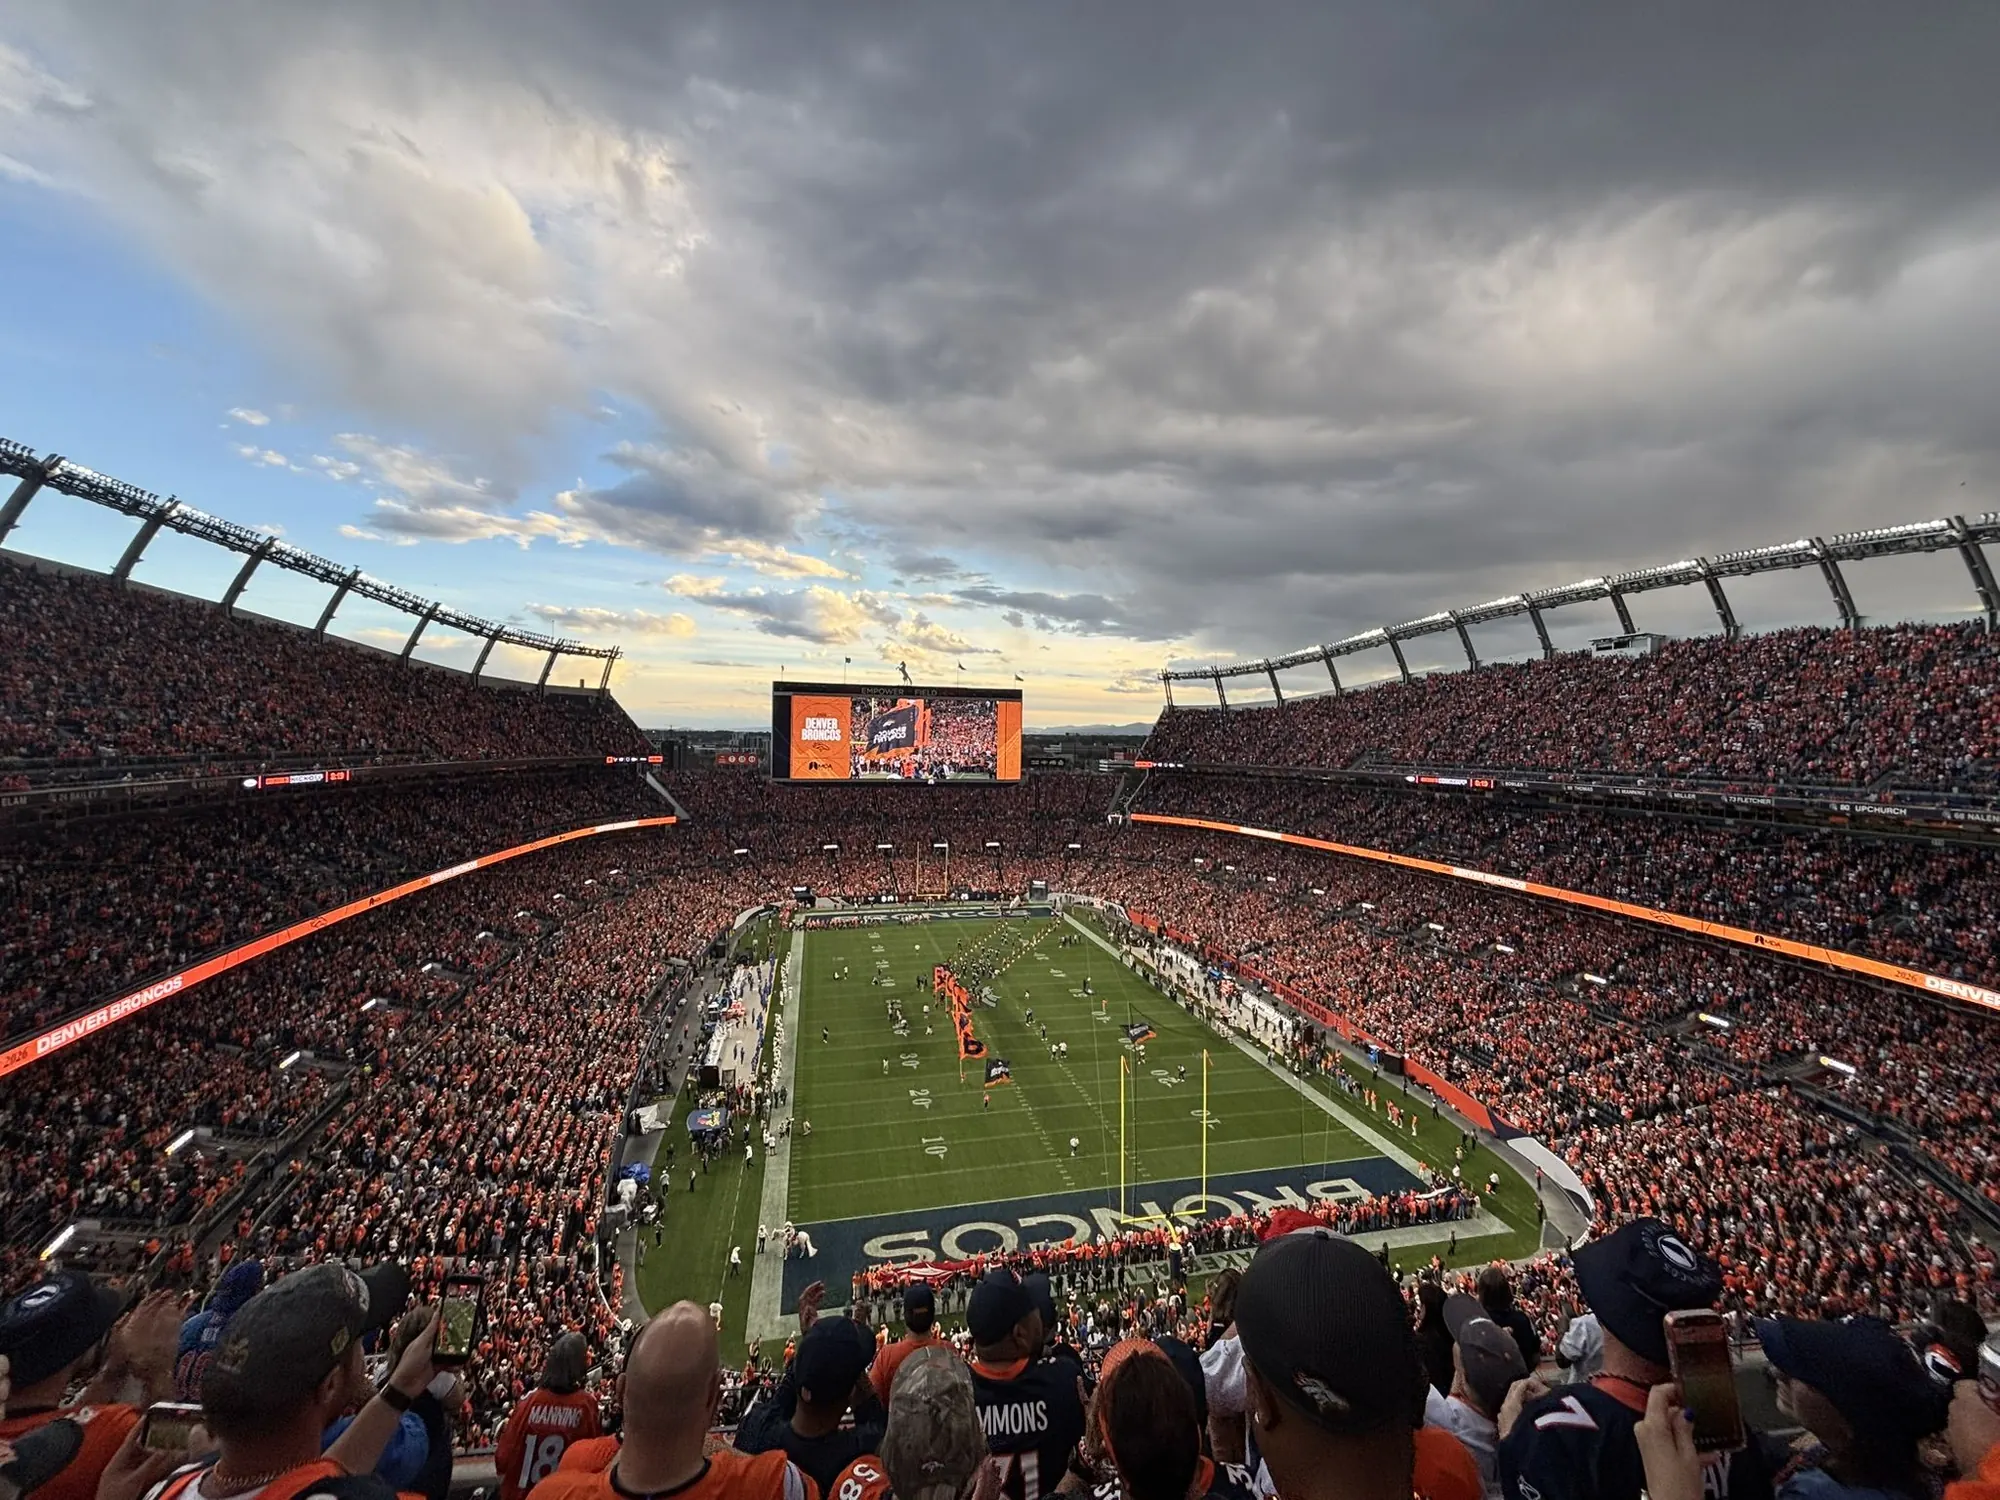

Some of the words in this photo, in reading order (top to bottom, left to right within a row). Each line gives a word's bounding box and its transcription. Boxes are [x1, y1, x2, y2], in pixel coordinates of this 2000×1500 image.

[805, 717, 838, 730] DENVER
[801, 729, 841, 741] BRONCOS
[1, 796, 27, 807] ELAM
[1737, 797, 1771, 805] FLETCHER
[1855, 805, 1907, 815] UPCHURCH
[1968, 813, 2000, 823] NALEN
[1894, 970, 1918, 983] 2026
[1925, 976, 2000, 1007] DENVE
[1280, 987, 1328, 1023] BRONCOS
[3, 1049, 28, 1068] 2026
[37, 1009, 109, 1054] DENVER
[110, 975, 183, 1018] BRONCOS
[900, 1053, 920, 1066] 30
[909, 1089, 932, 1106] 20
[922, 1136, 948, 1155] 10
[863, 1177, 1378, 1269] BRONCOS
[1534, 1395, 1600, 1431] 7
[518, 1434, 565, 1489] 18
[838, 1463, 880, 1500] 58
